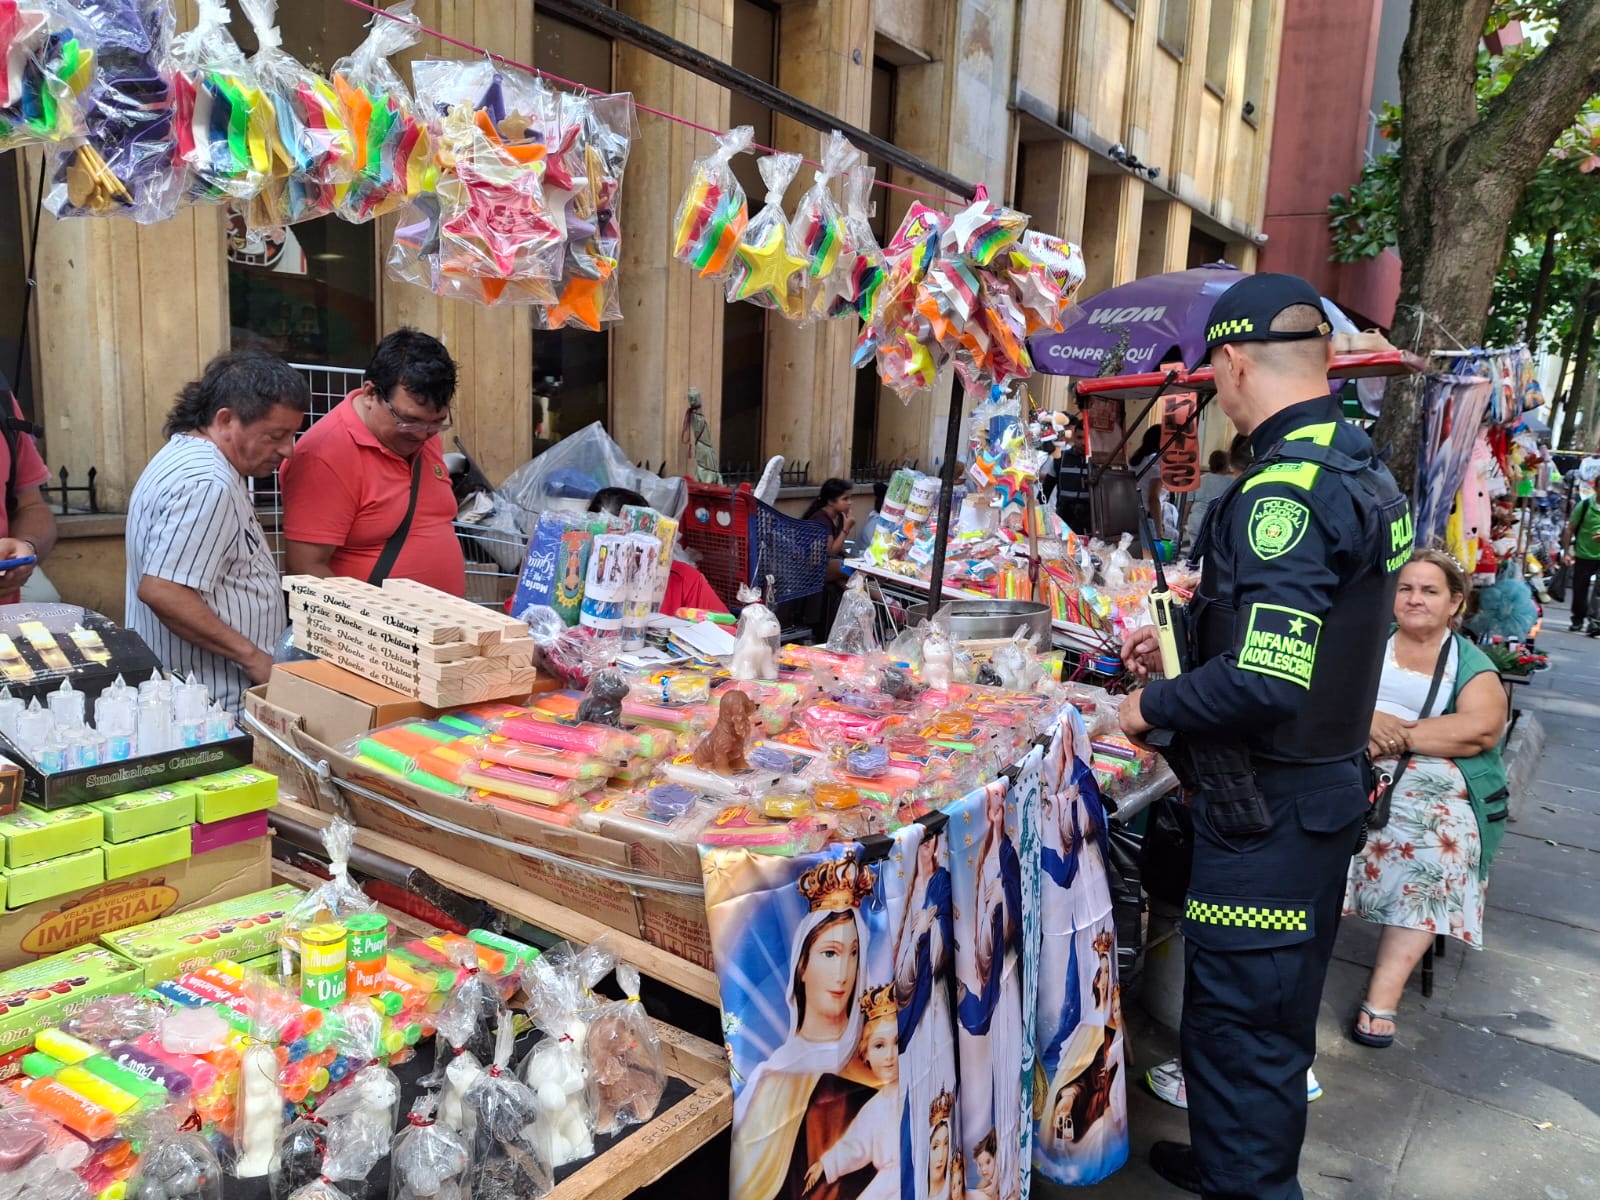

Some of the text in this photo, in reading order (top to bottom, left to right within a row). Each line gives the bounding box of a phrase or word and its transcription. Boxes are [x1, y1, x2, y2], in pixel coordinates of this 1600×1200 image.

[1088, 306, 1167, 325] WOM
[1049, 343, 1157, 364] COMPR QUÍ
[1254, 508, 1303, 529] NACIONAL
[323, 594, 352, 609] Noche
[360, 608, 370, 617] de
[382, 615, 413, 633] Velitas
[335, 613, 363, 631] Noche
[368, 628, 377, 637] de
[381, 632, 411, 650] Velitas
[337, 629, 363, 647] Noche
[368, 642, 377, 652] de
[381, 647, 411, 666] Velitas
[338, 641, 365, 660] Noche
[369, 656, 379, 665] de
[382, 661, 412, 679] Velitas
[1250, 630, 1312, 661] INFANCIA
[338, 655, 365, 673] Noche
[370, 670, 379, 680] de
[382, 674, 412, 694] Velitas
[86, 762, 166, 788] Smokeless
[168, 750, 224, 770] Candles
[38, 894, 162, 947] IMPERIAL
[63, 889, 146, 921] VELAS Y VELONES
